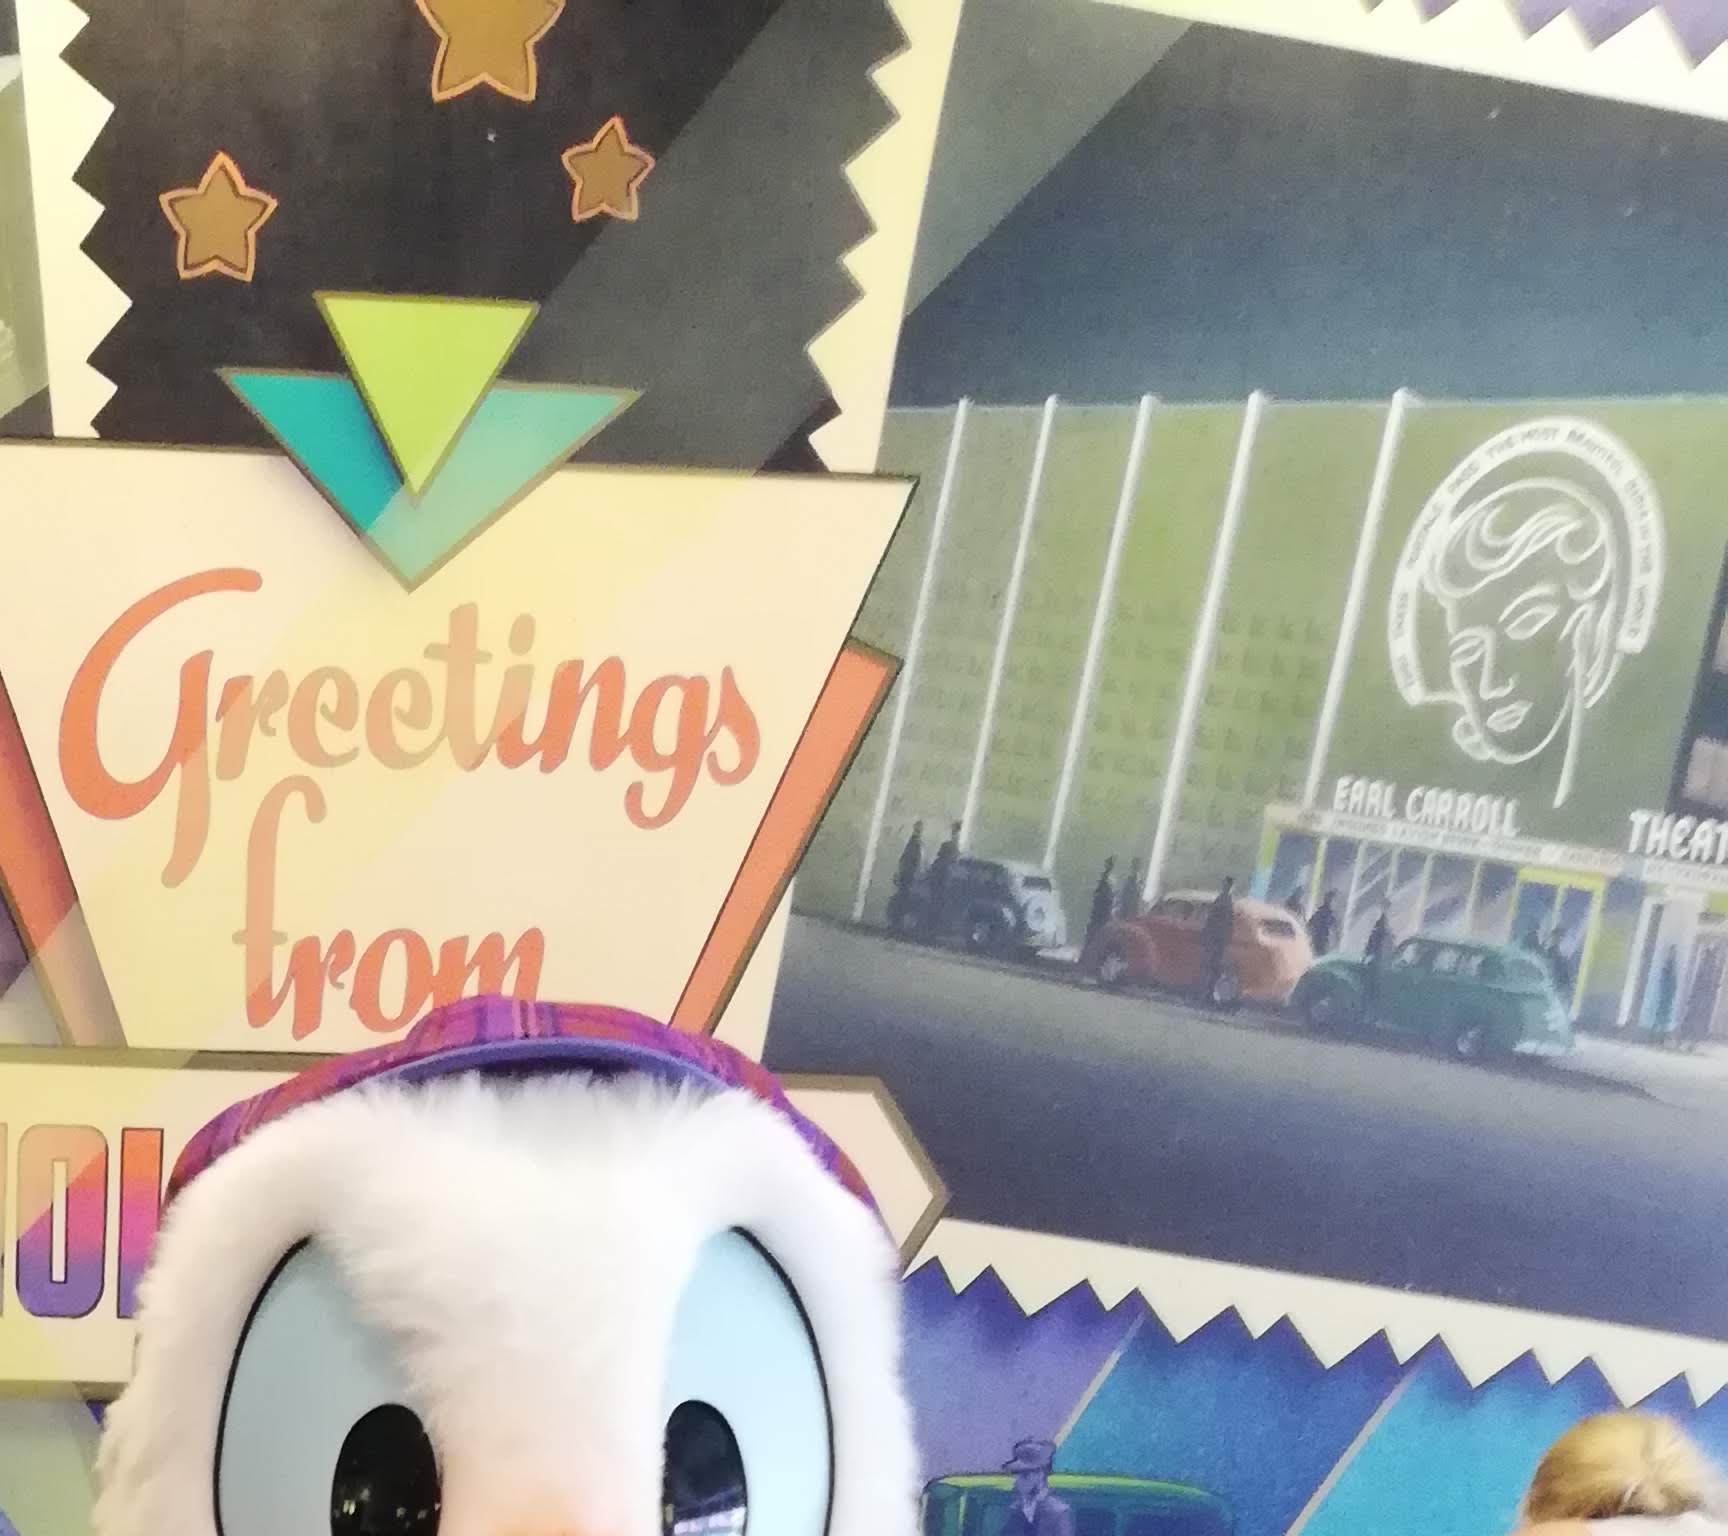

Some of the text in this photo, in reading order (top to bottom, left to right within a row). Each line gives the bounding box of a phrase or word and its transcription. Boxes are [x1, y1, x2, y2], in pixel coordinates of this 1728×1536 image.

[57, 566, 761, 889] Greetings
[1333, 775, 1521, 838] EARL CARROLL
[233, 775, 546, 1040] from
